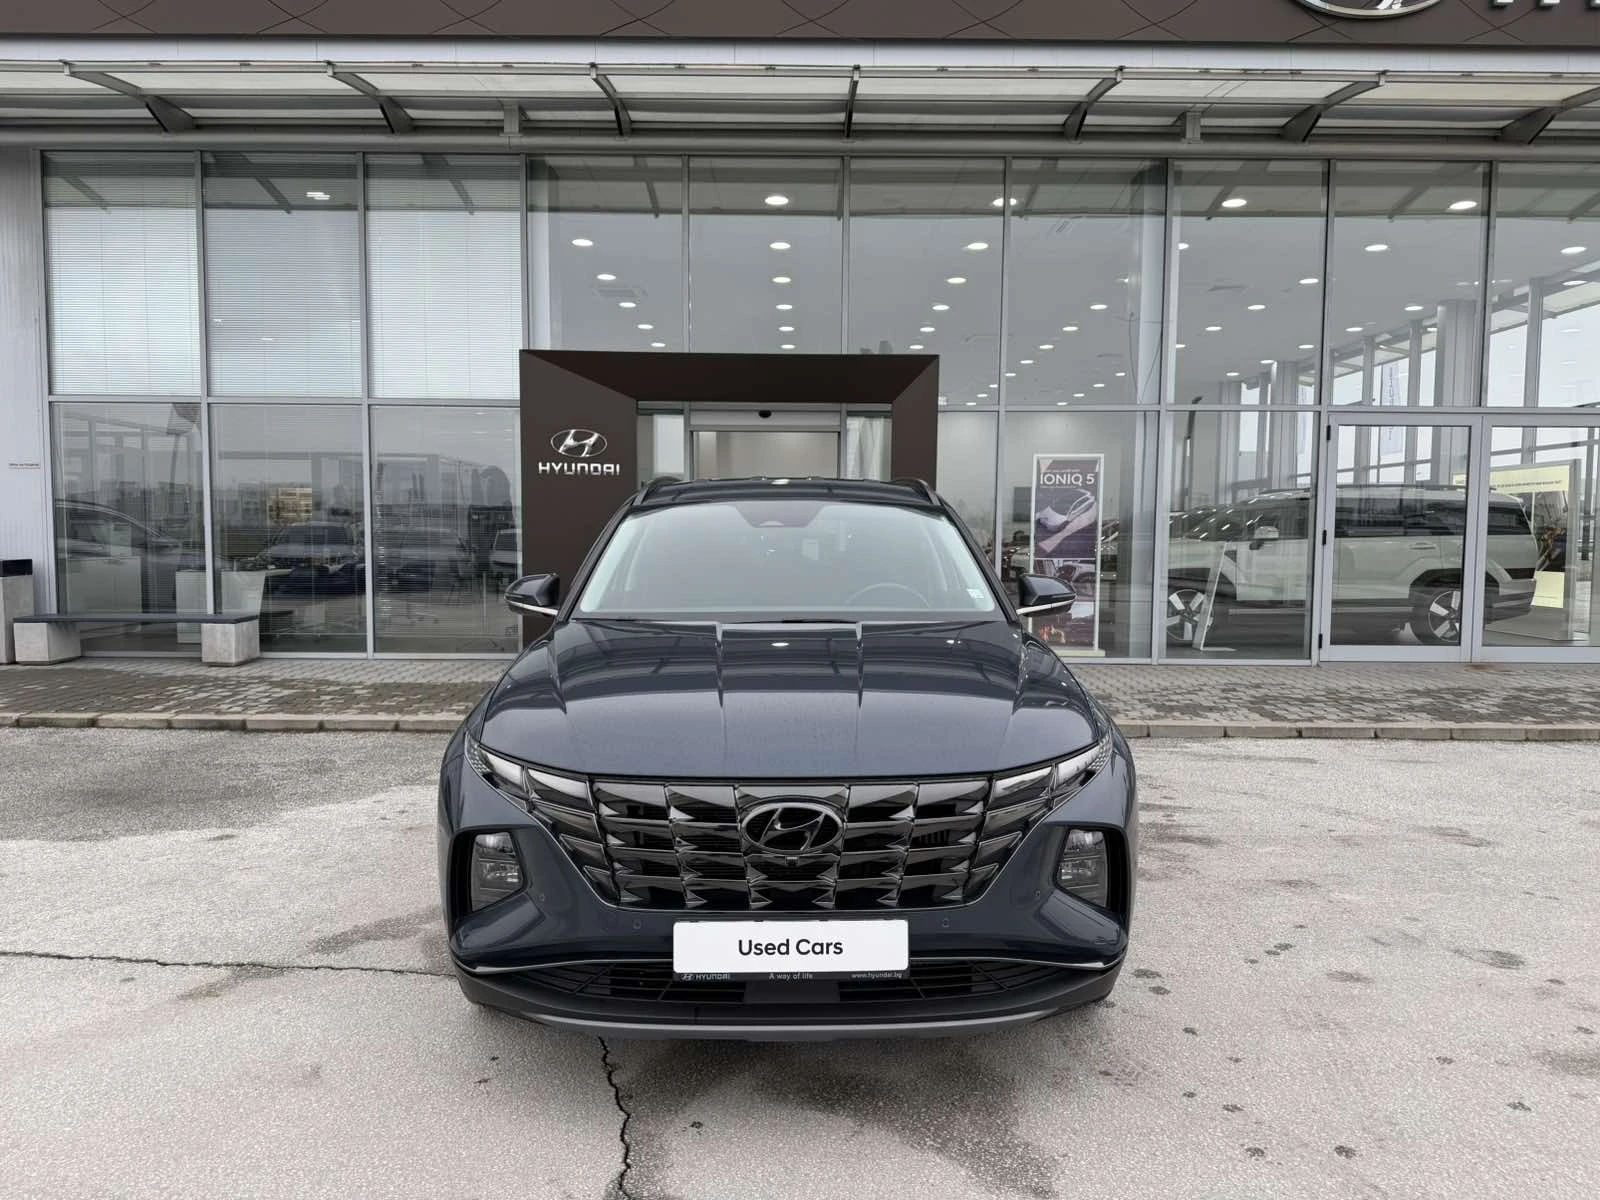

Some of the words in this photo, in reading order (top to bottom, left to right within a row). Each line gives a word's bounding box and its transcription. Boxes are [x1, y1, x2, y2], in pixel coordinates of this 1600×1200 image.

[538, 462, 620, 475] HYUNDAI
[1040, 473, 1083, 486] IONIQ
[1086, 474, 1095, 485] 5
[738, 938, 790, 956] Used
[795, 938, 844, 956] Cars
[777, 973, 790, 981] way
[792, 972, 800, 980] of
[802, 972, 813, 980] life
